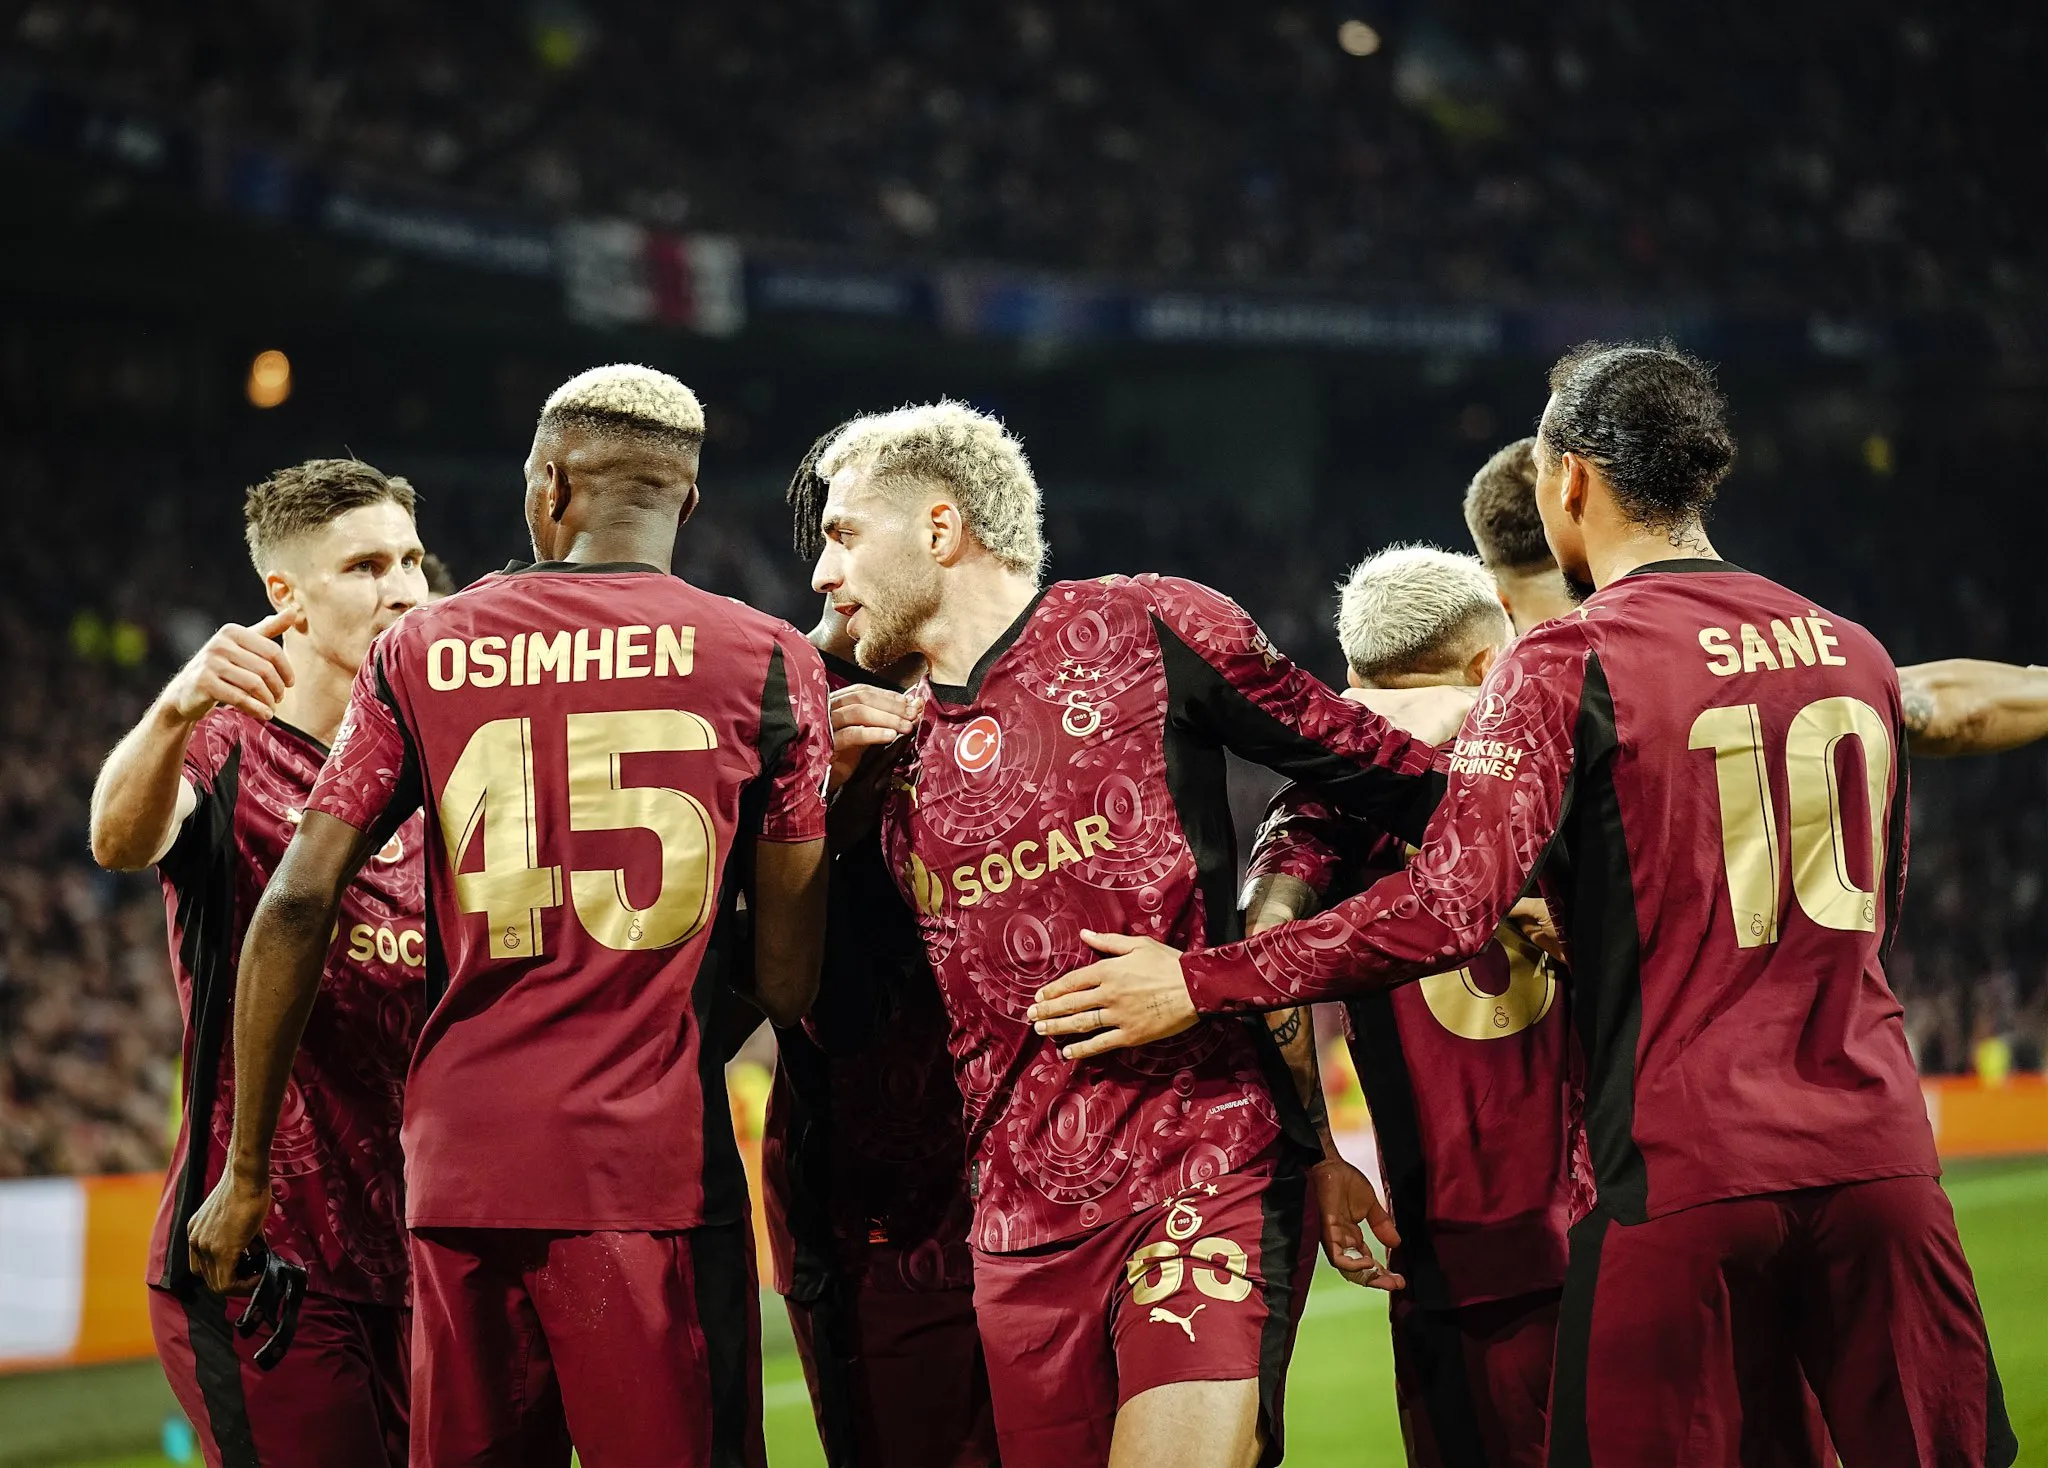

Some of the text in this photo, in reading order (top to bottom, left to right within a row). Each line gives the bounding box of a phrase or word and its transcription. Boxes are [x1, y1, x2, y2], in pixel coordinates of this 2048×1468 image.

[427, 624, 696, 692] OSIMHEN
[1698, 609, 1847, 677] SANÉ
[1449, 756, 1516, 781] IRLINES
[440, 708, 719, 960] 45
[1688, 696, 1891, 949] 10
[952, 814, 1117, 906] SOCAR
[347, 923, 426, 967] SOC
[1209, 1098, 1250, 1115] ULTRAWEAVE
